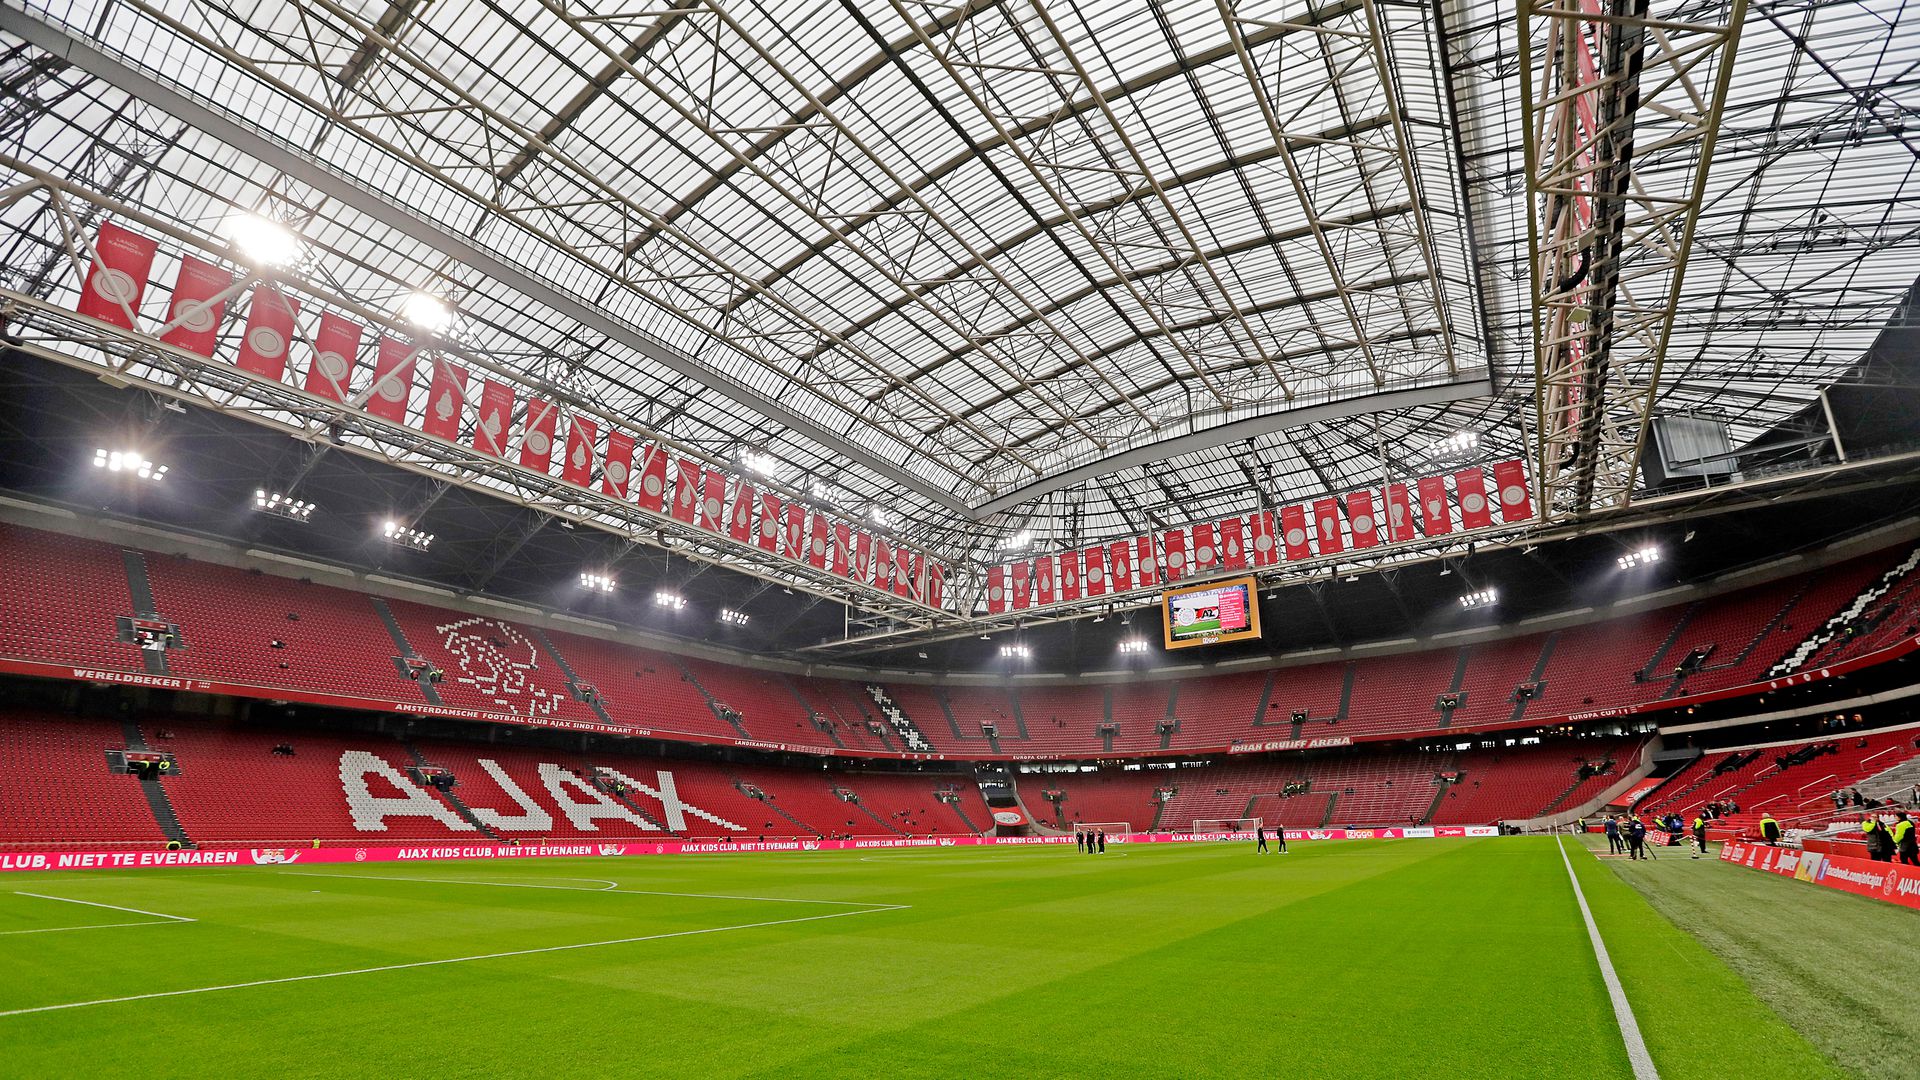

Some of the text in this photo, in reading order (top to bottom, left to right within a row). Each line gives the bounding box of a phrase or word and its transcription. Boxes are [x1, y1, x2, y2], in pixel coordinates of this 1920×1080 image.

[73, 669, 181, 687] WERELDBEKER
[395, 704, 479, 718] AMSTERDAMSCHE
[482, 712, 525, 723] FOOTBALL
[527, 717, 548, 725] CLUB
[550, 719, 571, 728] AJAX
[573, 722, 594, 730] SINDS
[607, 726, 632, 734] MAART
[1568, 712, 1599, 721] EUROPA
[1600, 709, 1616, 717] CUP
[1229, 743, 1262, 752] JOHAN
[1309, 737, 1351, 748] ARENA
[338, 750, 748, 831] AJAX
[398, 845, 592, 859] AJAX KIDS CLUB, NIET TE EVENAREN
[681, 844, 700, 852] AJAX
[701, 844, 719, 852] KIDS
[719, 843, 739, 852] CLUB,
[740, 843, 756, 851] NIET
[766, 842, 799, 850] EVENAREN
[58, 854, 107, 867] NIET
[112, 853, 136, 866] TE
[140, 852, 238, 866] EVENAREN
